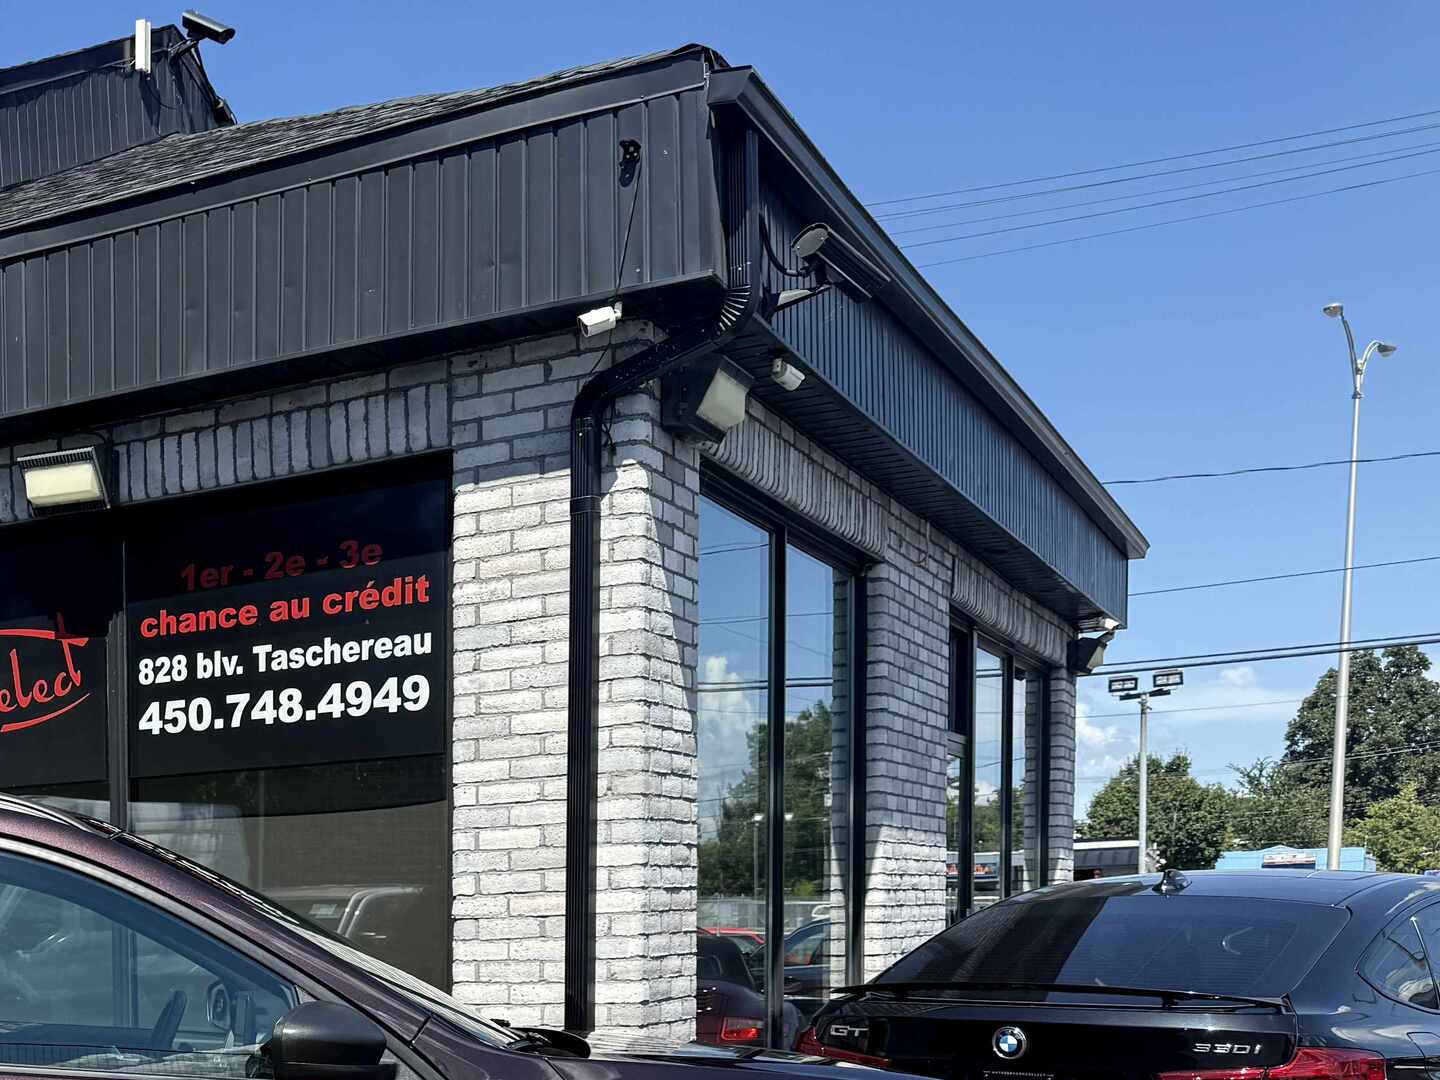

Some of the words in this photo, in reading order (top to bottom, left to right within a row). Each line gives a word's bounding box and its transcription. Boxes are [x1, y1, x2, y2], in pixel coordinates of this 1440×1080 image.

[181, 563, 234, 591] 1er
[263, 551, 306, 580] 2e
[339, 539, 383, 569] 3e
[140, 604, 258, 638] chance
[268, 597, 310, 623] au
[322, 574, 430, 615] crédit
[137, 654, 188, 686] 828
[196, 650, 244, 679] blv.
[252, 631, 433, 673] Taschereau
[137, 673, 431, 736] 450.748.4949
[829, 1024, 870, 1037] GT
